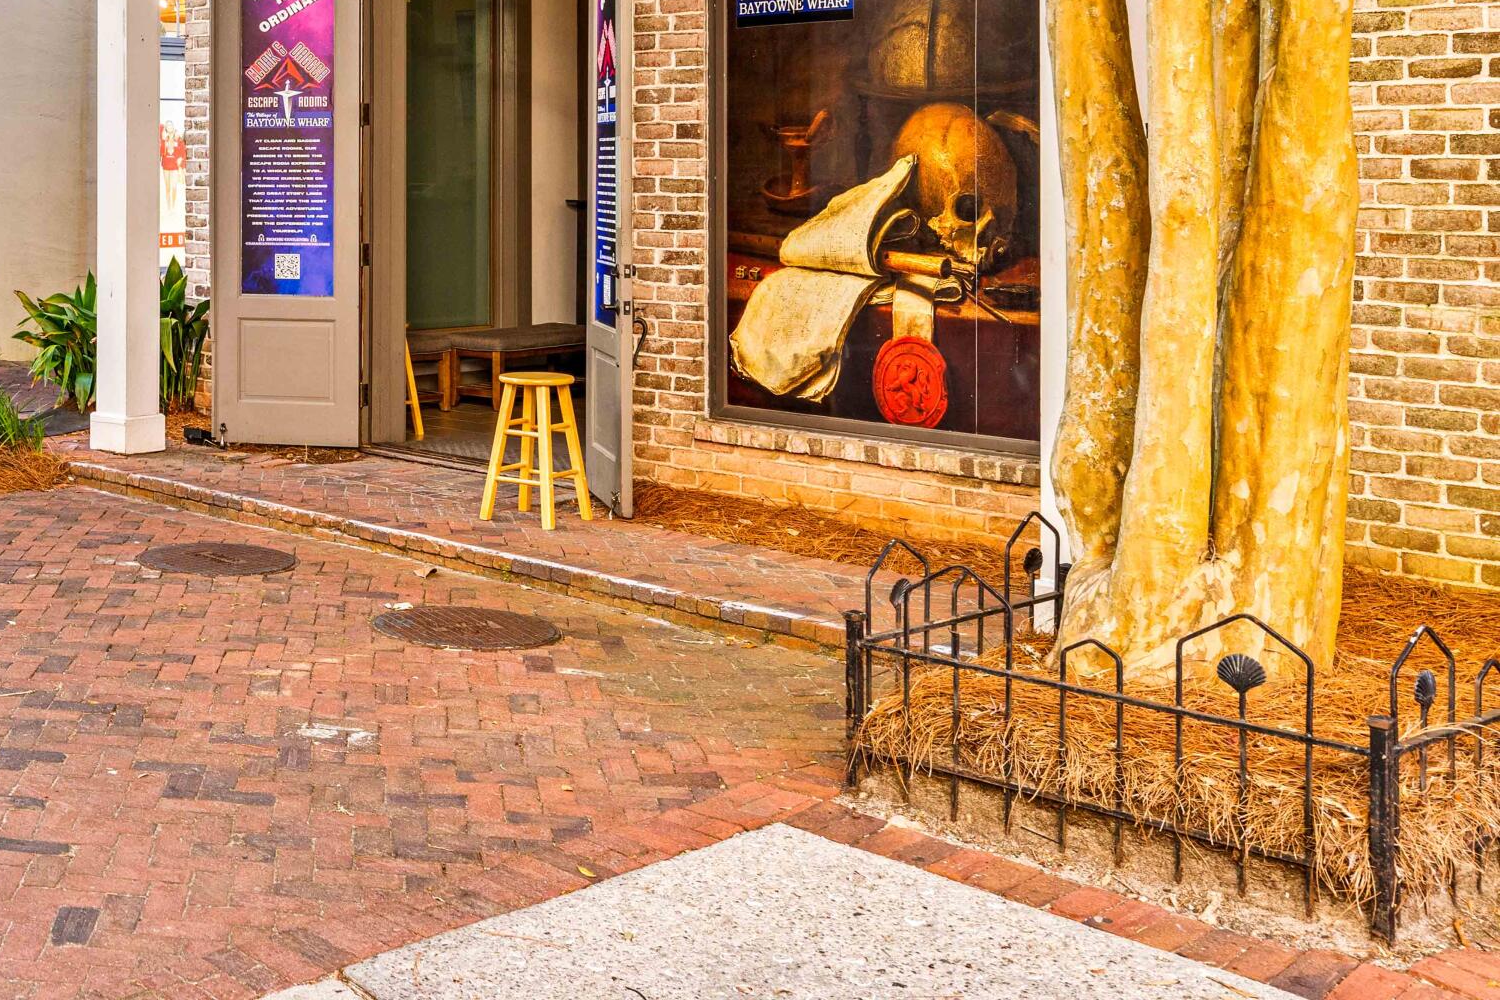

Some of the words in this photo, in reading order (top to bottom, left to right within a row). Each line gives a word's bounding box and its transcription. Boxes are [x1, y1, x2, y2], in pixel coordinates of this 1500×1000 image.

[245, 48, 281, 84] CLOAK
[289, 42, 330, 83] DAGGER
[248, 97, 278, 108] ESCAPE
[298, 96, 328, 108] ROOMS
[246, 118, 296, 127] BAYTOWNE
[297, 118, 330, 127] WHARF
